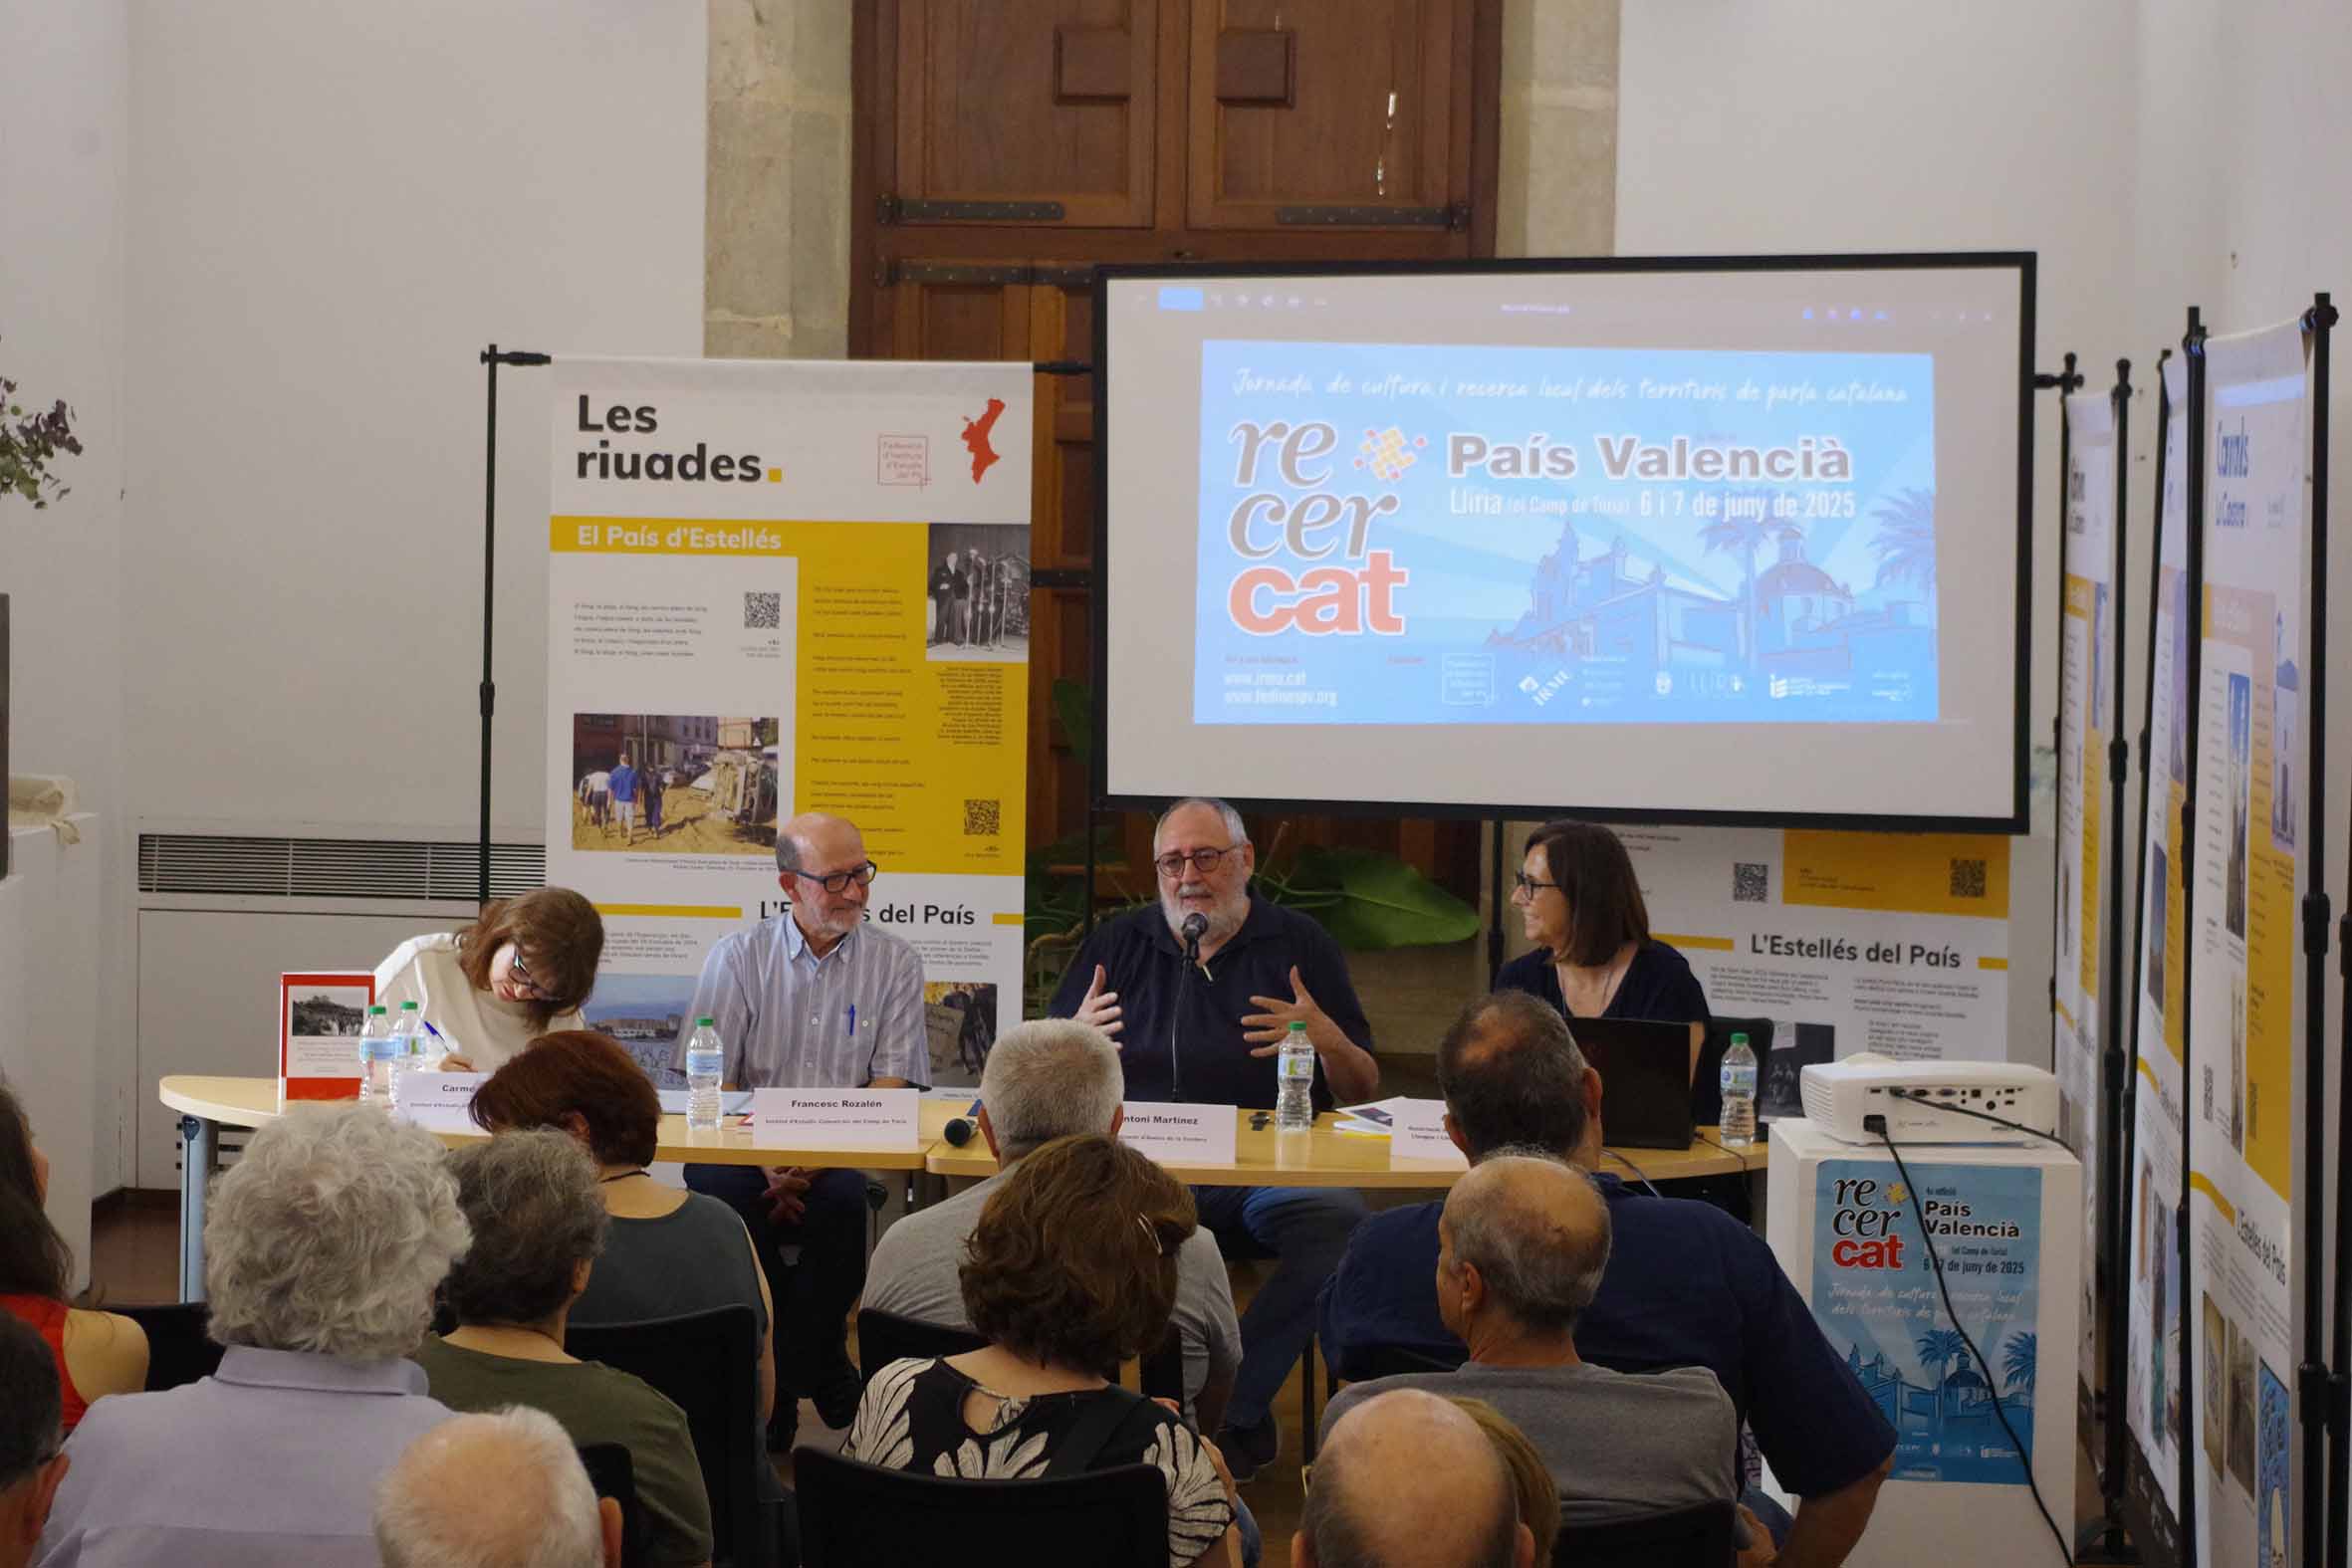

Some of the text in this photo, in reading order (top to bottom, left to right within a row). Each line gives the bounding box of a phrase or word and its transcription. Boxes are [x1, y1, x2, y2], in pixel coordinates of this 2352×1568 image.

[1234, 365, 1312, 395] Jornada
[1326, 371, 1351, 394] de
[1361, 372, 1434, 402] cultura
[1456, 381, 1529, 397] recerca
[1737, 378, 1762, 400] de
[1824, 380, 1909, 405] catalana
[579, 393, 657, 433] Les
[577, 439, 783, 484] riuades.
[1227, 419, 1336, 488] re
[1449, 432, 1853, 482] País Valencià
[1450, 487, 1502, 516] Llíria
[1640, 490, 1652, 517] 6
[1674, 491, 1685, 518] 7
[1694, 492, 1718, 518] de
[1723, 492, 1767, 524] juny
[1773, 492, 1796, 519] de
[1802, 491, 1856, 519] 2025
[578, 525, 783, 551] El País d'Estellés
[1227, 491, 1399, 560] cer
[1226, 549, 1409, 637] cat
[878, 903, 915, 924] del
[923, 903, 976, 926] País
[1751, 932, 1962, 970] L'Estellés del País
[791, 1099, 882, 1108] Francesc Rozalén
[1123, 1115, 1199, 1125] ntoni Martínez
[1833, 1177, 1877, 1208] re
[1924, 1200, 1972, 1217] País
[1832, 1206, 1902, 1239] cer
[1924, 1219, 2020, 1238] Valencià
[1832, 1234, 1905, 1269] cat
[1947, 1259, 1960, 1272] de
[1962, 1260, 1985, 1275] juny
[1986, 1261, 1999, 1273] de
[1999, 1260, 2024, 1274] 2025
